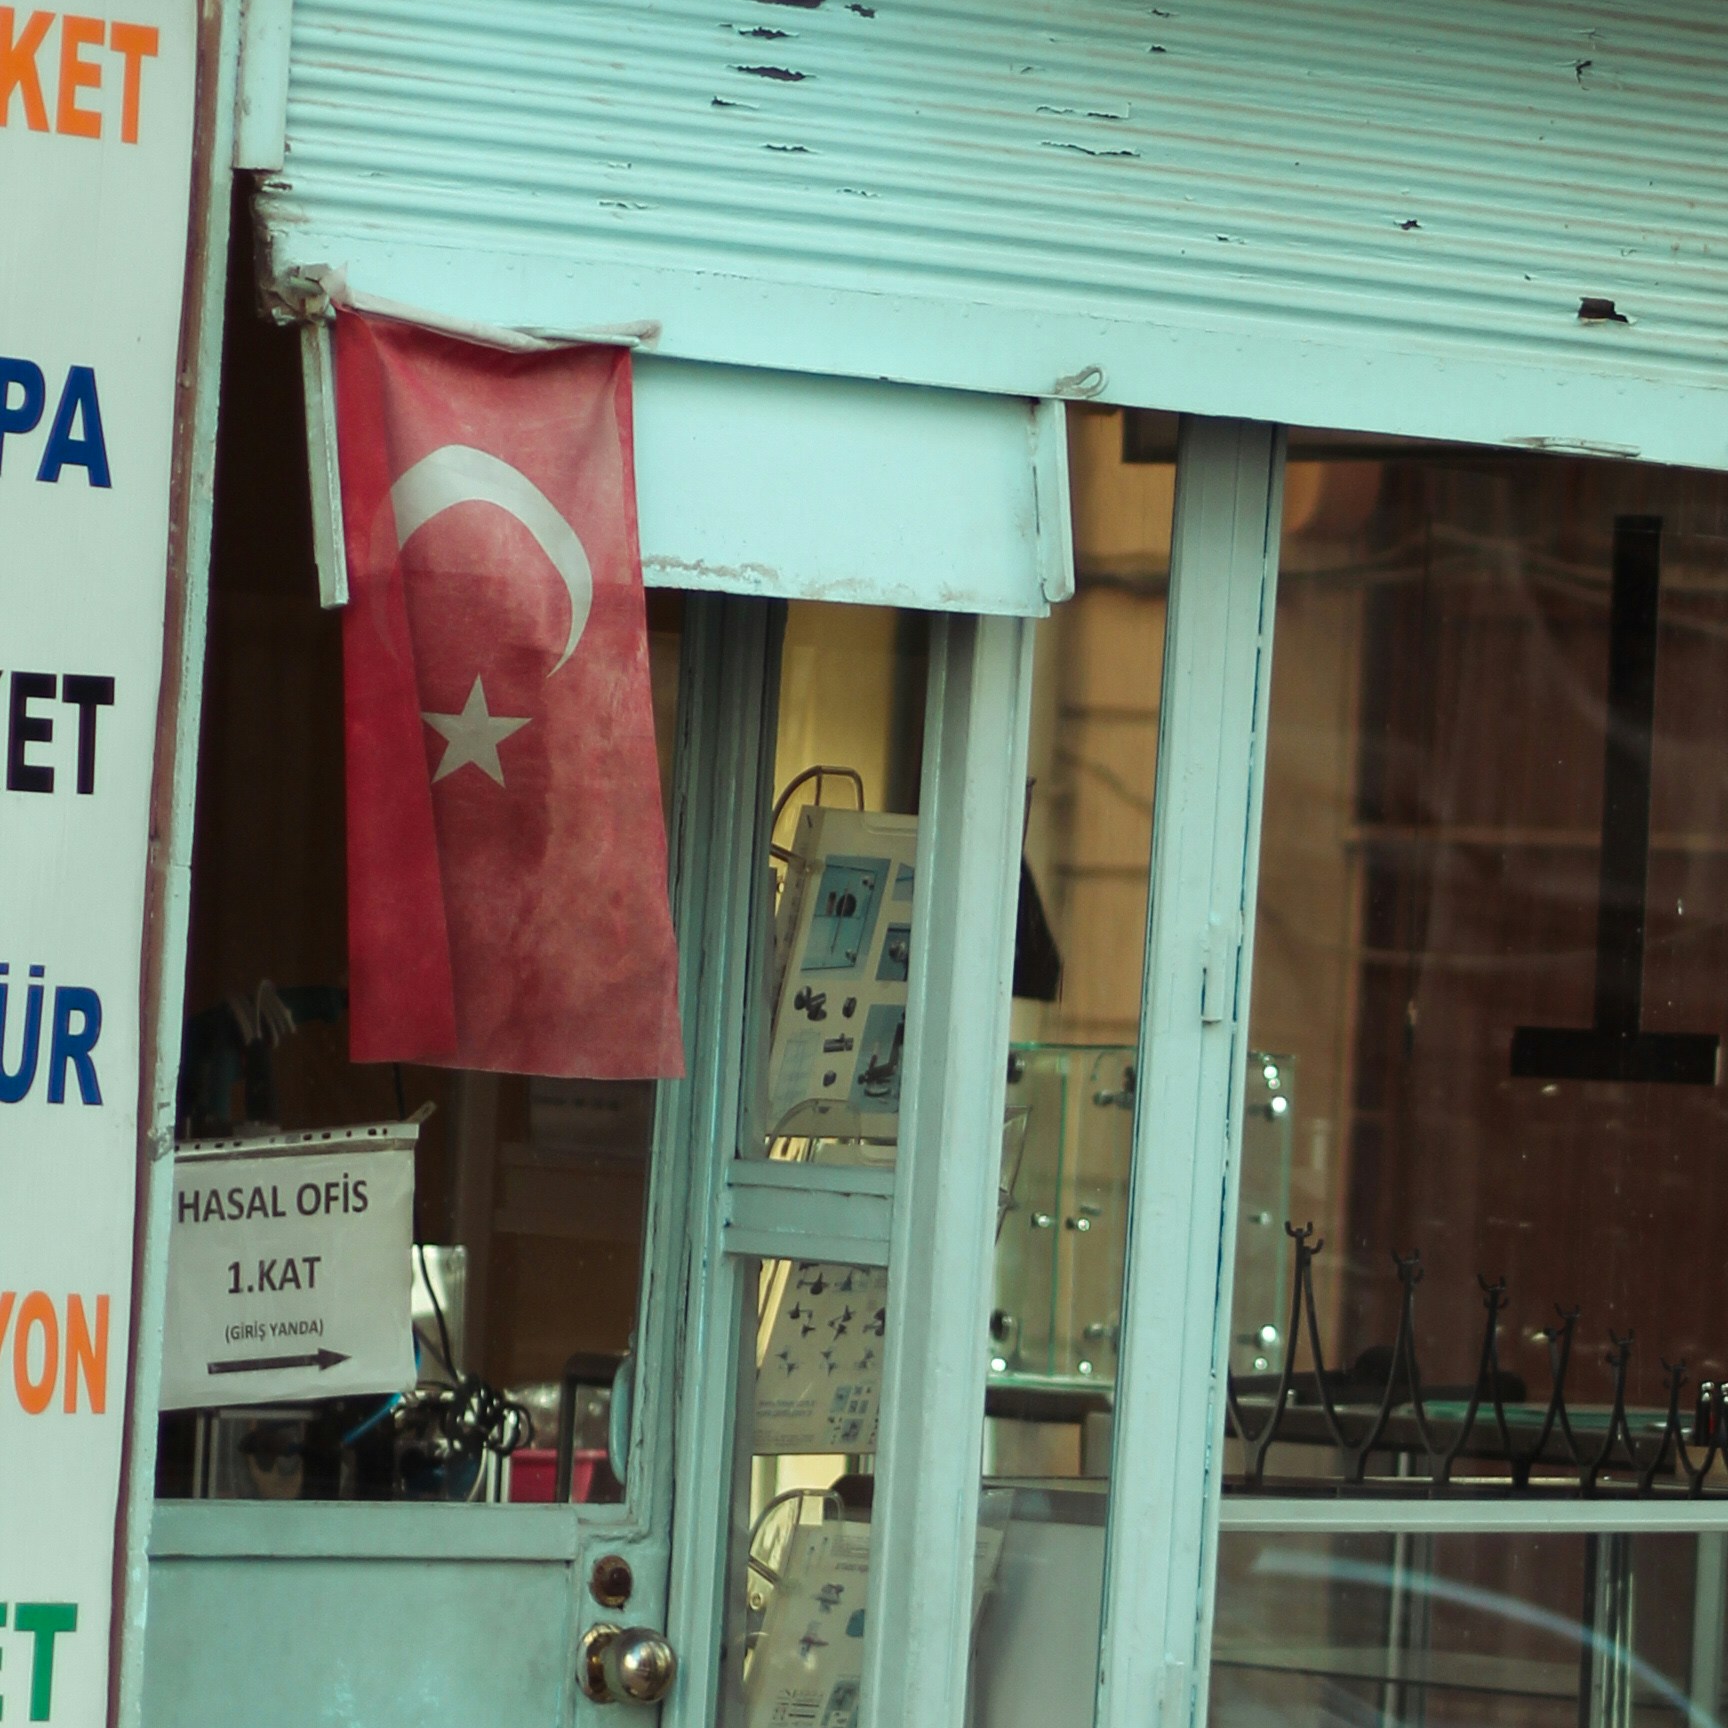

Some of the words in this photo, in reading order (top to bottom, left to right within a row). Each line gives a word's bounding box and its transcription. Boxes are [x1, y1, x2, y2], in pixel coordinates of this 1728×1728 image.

[0, 5, 160, 145] KET
[0, 669, 116, 795] ET
[0, 961, 104, 1106] ÜR
[177, 1184, 287, 1223] HASAL
[295, 1172, 370, 1217] OFİS
[226, 1256, 322, 1294] 1.KAT
[224, 1320, 266, 1344] (GİRİŞ
[269, 1318, 324, 1337] YANDA)
